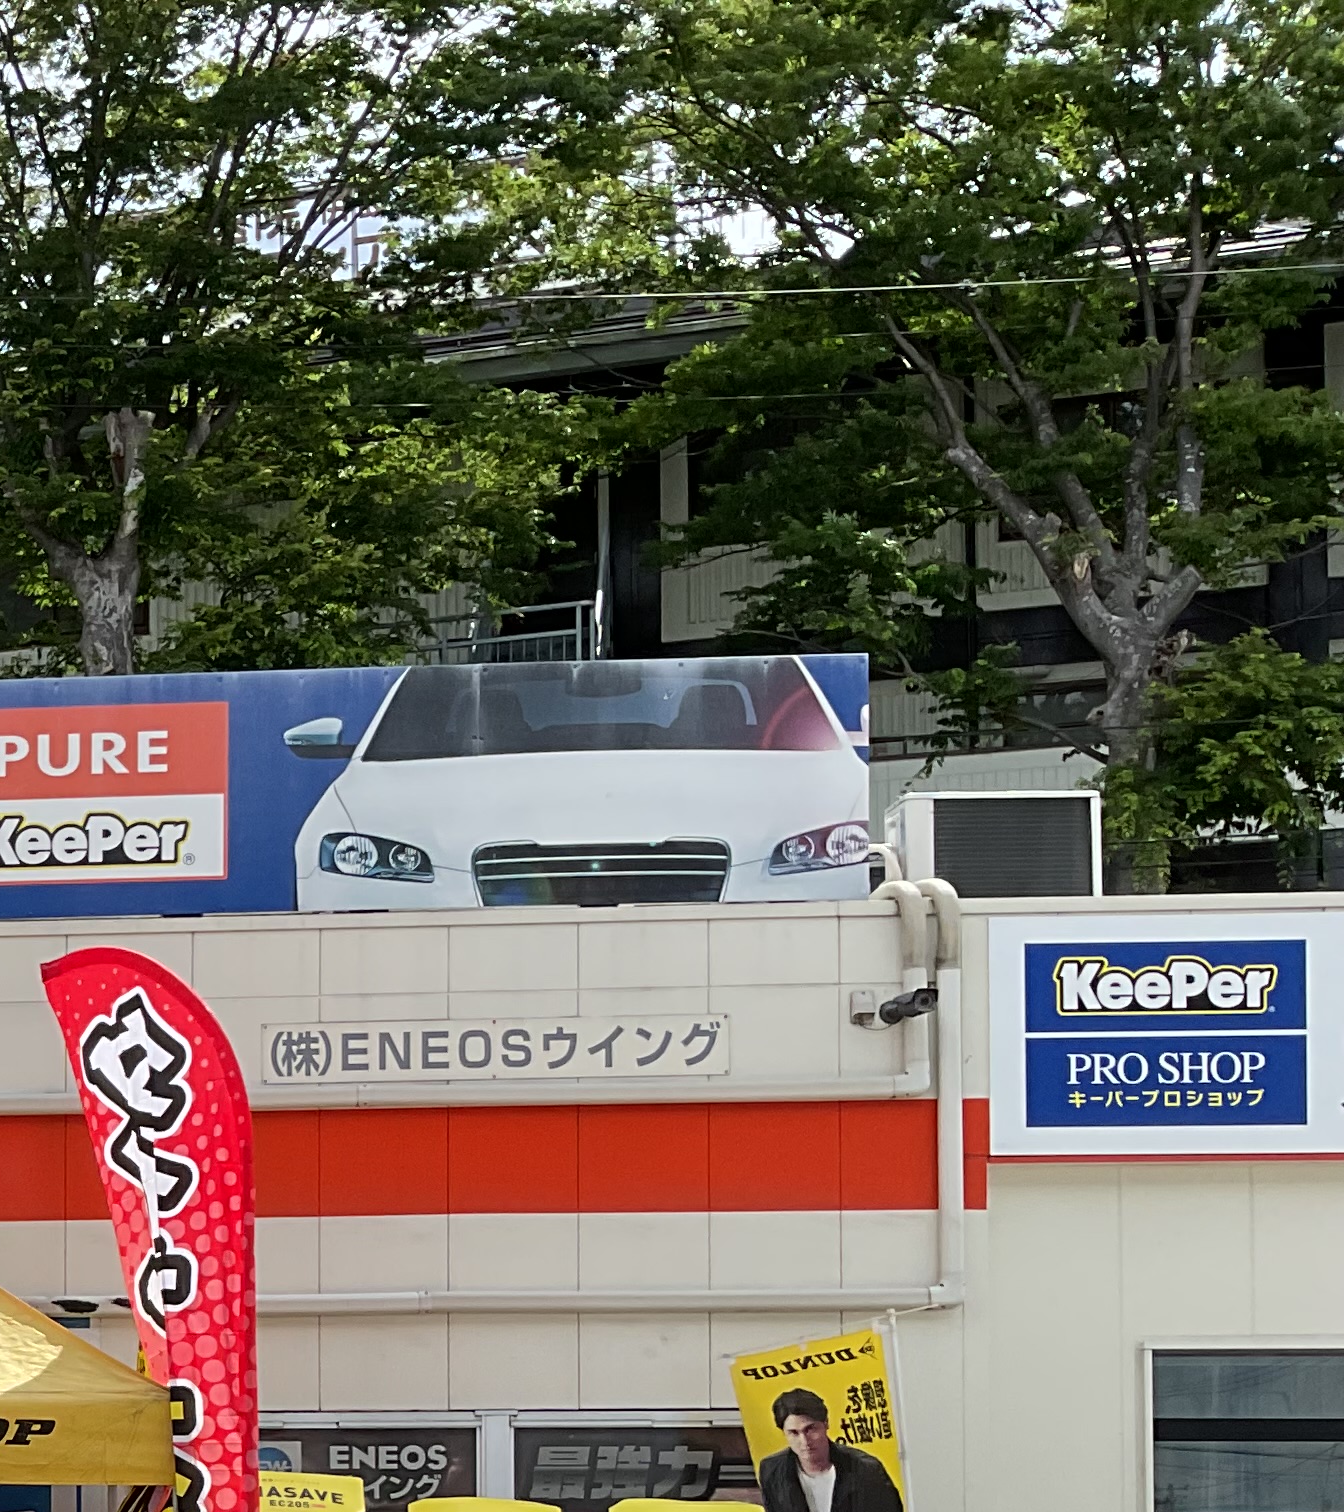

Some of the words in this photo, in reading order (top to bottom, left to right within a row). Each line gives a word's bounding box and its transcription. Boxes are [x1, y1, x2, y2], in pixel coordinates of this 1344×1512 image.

[1053, 956, 1277, 1016] KeePer
[1067, 1052, 1148, 1084] PRO
[1158, 1051, 1265, 1083] SHOP
[1068, 1090, 1263, 1108] キーパープロショップ
[329, 1444, 447, 1471] ENEOS
[365, 1474, 442, 1500] イング
